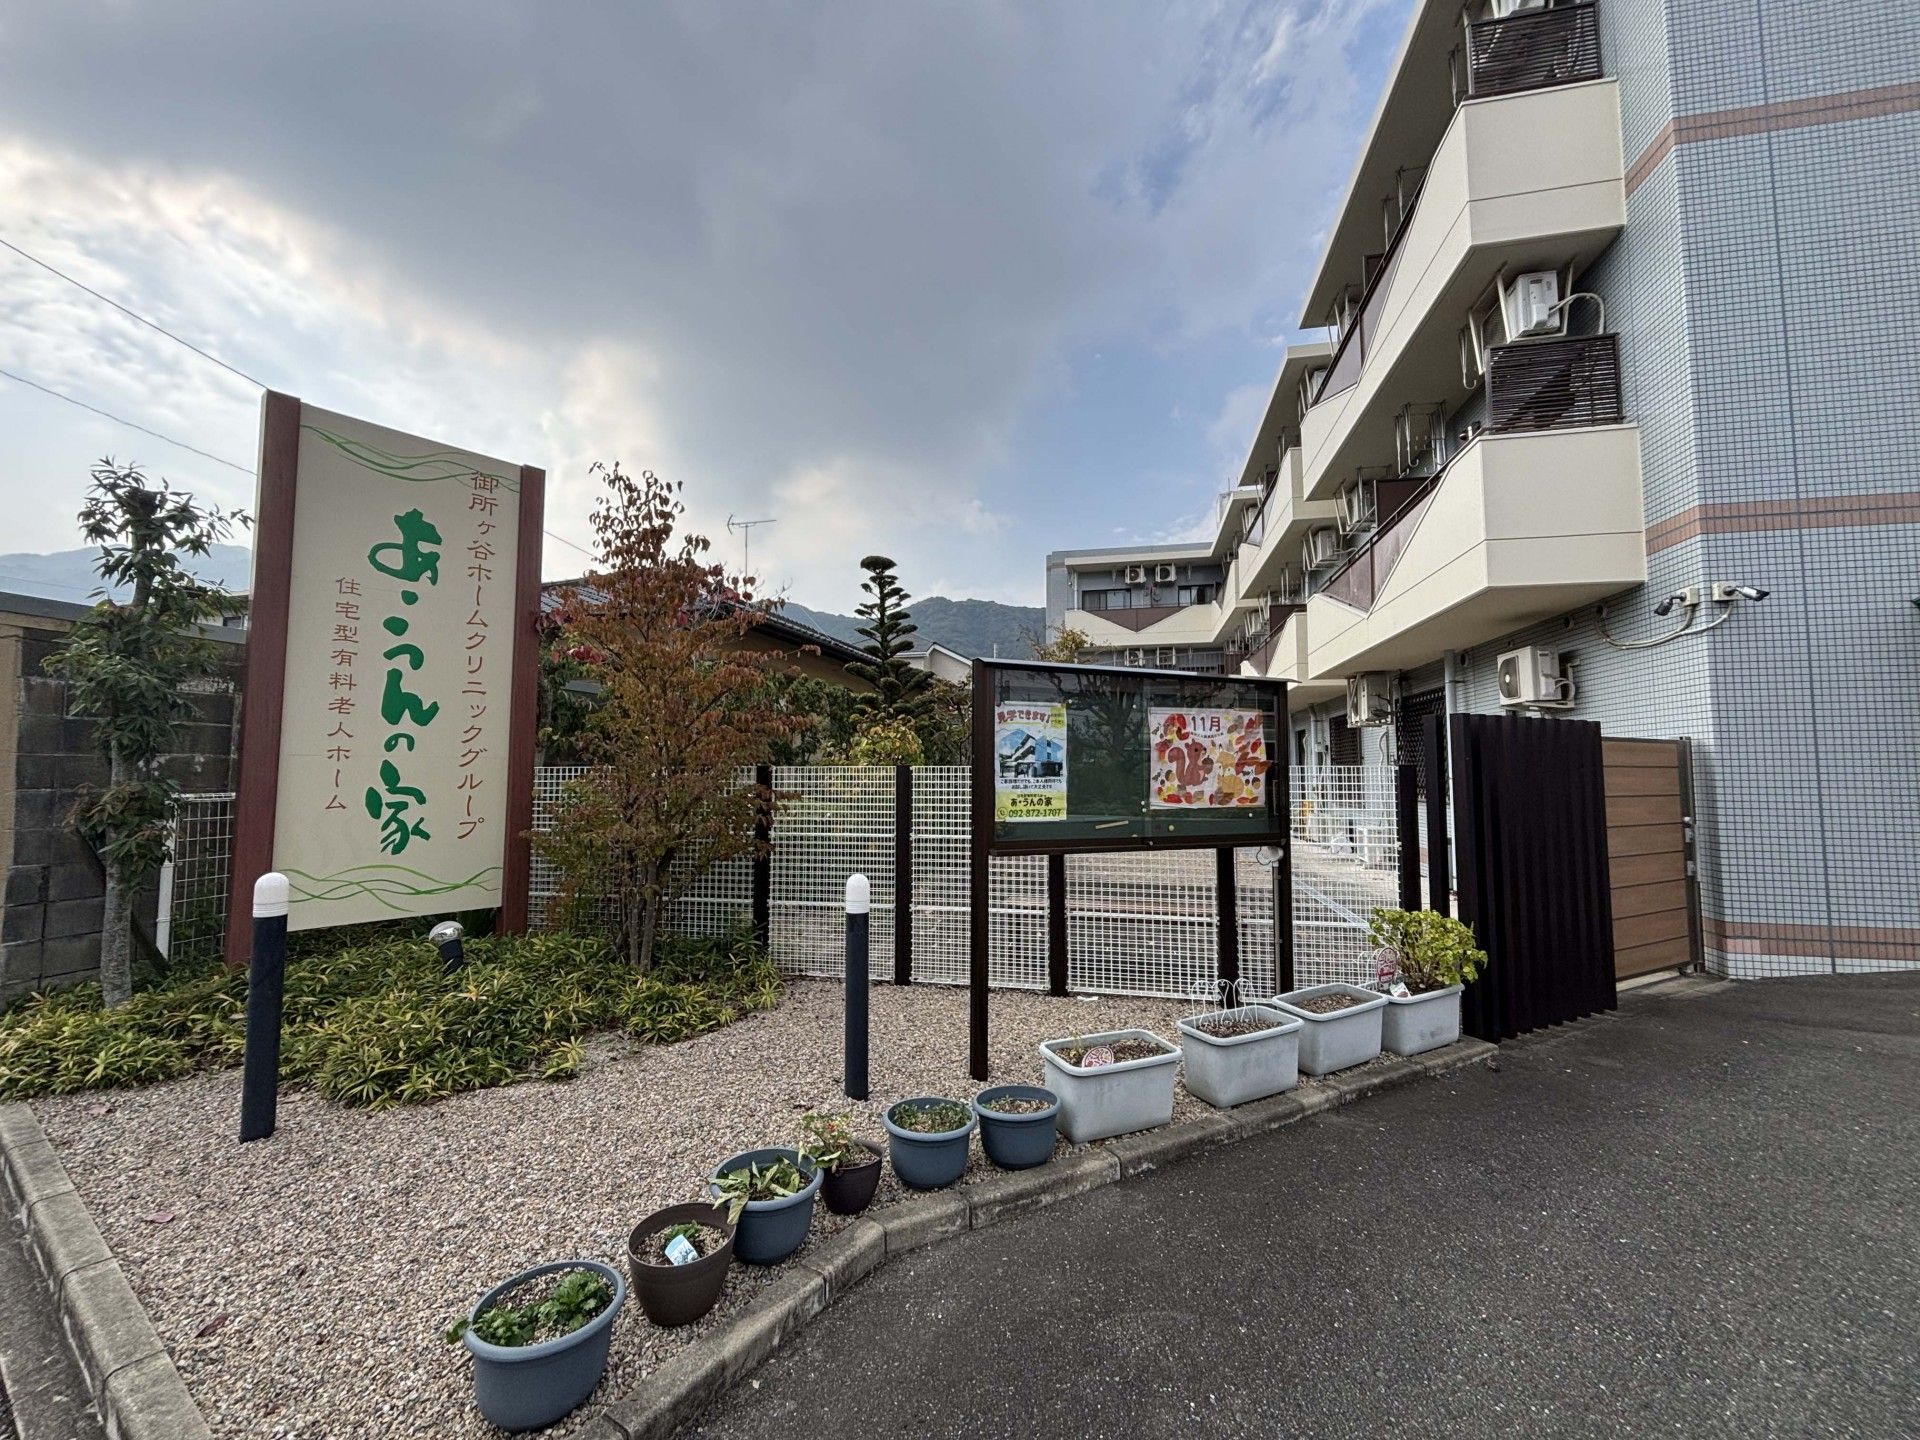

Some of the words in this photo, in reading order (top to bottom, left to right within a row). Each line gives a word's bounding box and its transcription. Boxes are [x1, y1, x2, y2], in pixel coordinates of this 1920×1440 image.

[325, 576, 362, 810] 住宅型有料老人ホーム
[1191, 715, 1221, 732] 11月
[1010, 796, 1053, 807] あ・うんの家
[1008, 808, 1062, 818] 092-872-1707
